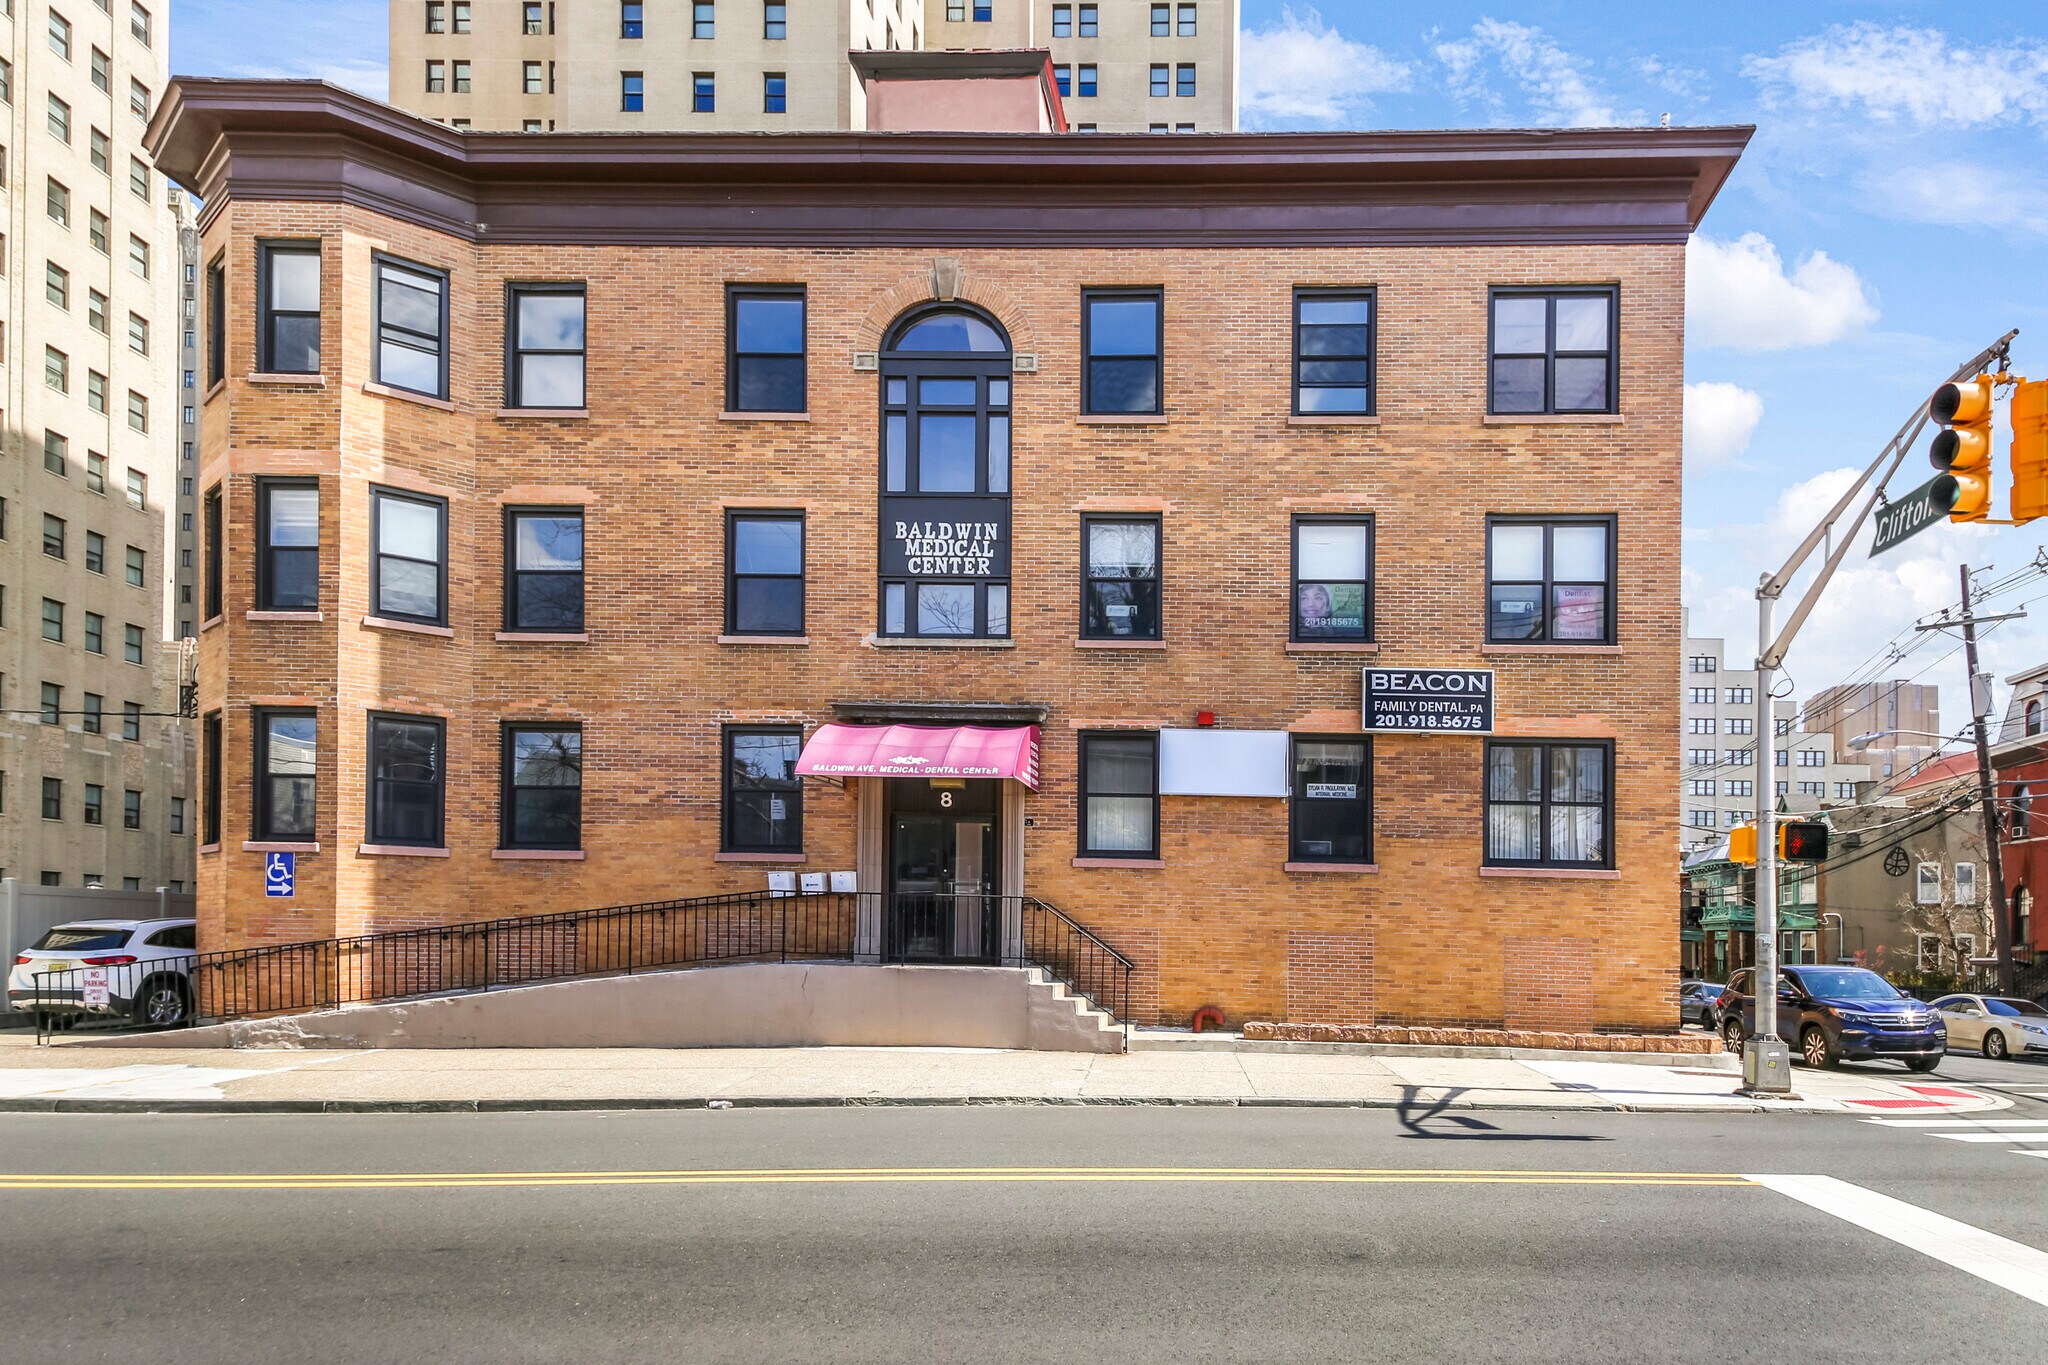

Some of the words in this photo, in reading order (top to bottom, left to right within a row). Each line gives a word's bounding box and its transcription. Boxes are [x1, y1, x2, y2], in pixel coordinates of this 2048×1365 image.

[1875, 496, 1932, 547] Clifton
[895, 521, 998, 540] BALDWIN
[904, 538, 994, 557] MEDICAL
[907, 557, 991, 575] CENTER
[1304, 617, 1359, 626] 2019185675
[1371, 673, 1487, 692] BEACON
[1374, 701, 1417, 712] FAMILY
[1470, 704, 1483, 713] PA
[1375, 714, 1482, 728] 201.918.5675
[812, 764, 855, 772] BALDWIN
[962, 766, 999, 775] CENTER
[940, 791, 953, 807] 8
[90, 971, 100, 979] NO
